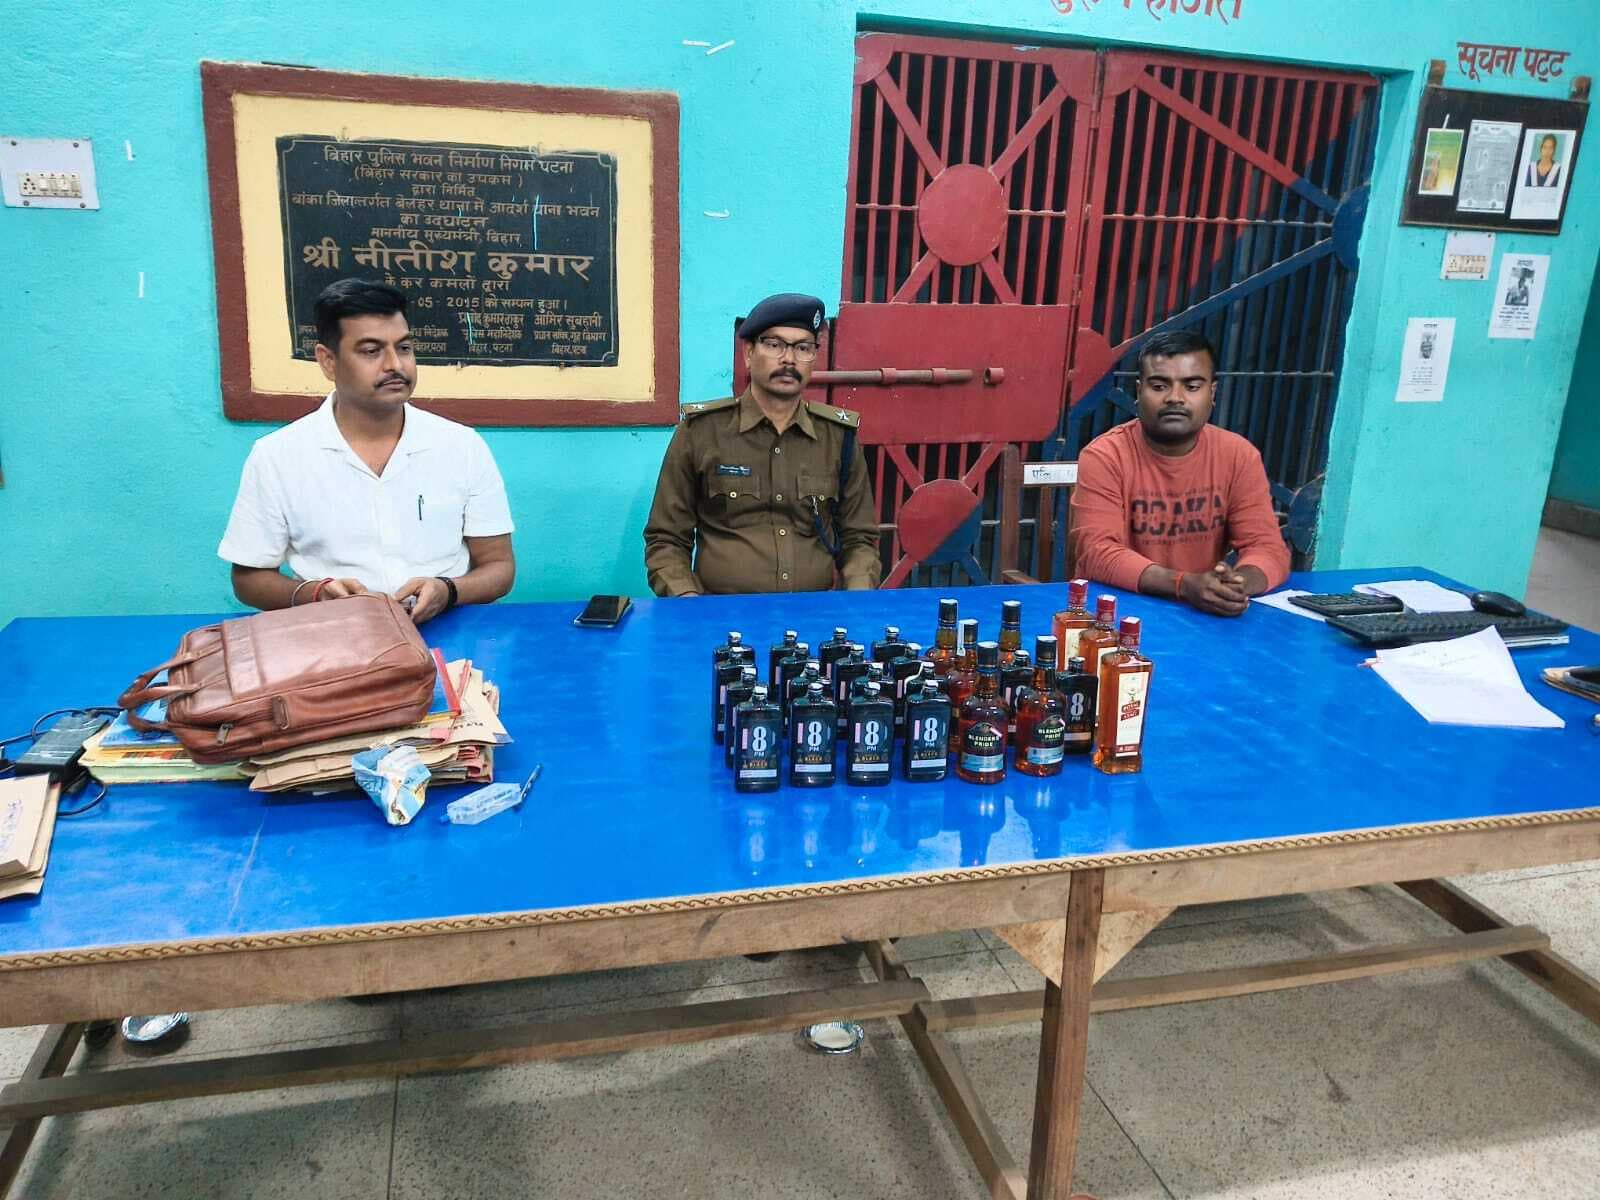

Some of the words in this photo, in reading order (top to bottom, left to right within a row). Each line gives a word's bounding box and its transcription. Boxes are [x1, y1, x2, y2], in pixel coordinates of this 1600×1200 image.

[1456, 41, 1523, 83] सूचना
[324, 145, 364, 165] बिहार
[367, 147, 406, 167] पुलिस
[410, 152, 443, 167] भवन
[448, 151, 496, 169] निर्माण
[538, 160, 575, 175] पटना
[399, 169, 443, 183] सरकार
[447, 171, 463, 183] का
[441, 182, 476, 197] निर्मित
[394, 195, 435, 212] बेलहर
[566, 204, 601, 217] भवन
[399, 213, 420, 226] का
[370, 225, 421, 240] माननीय
[303, 236, 342, 270] श्री
[351, 238, 477, 274] नीतीश
[487, 251, 595, 281] कुमार
[384, 272, 397, 288] के
[400, 277, 425, 289] कर
[446, 297, 480, 309] 2015
[1070, 692, 1084, 716] 8
[752, 726, 767, 752] 8
[807, 721, 822, 747] 8
[864, 720, 880, 747] 8
[923, 717, 938, 742] 8
